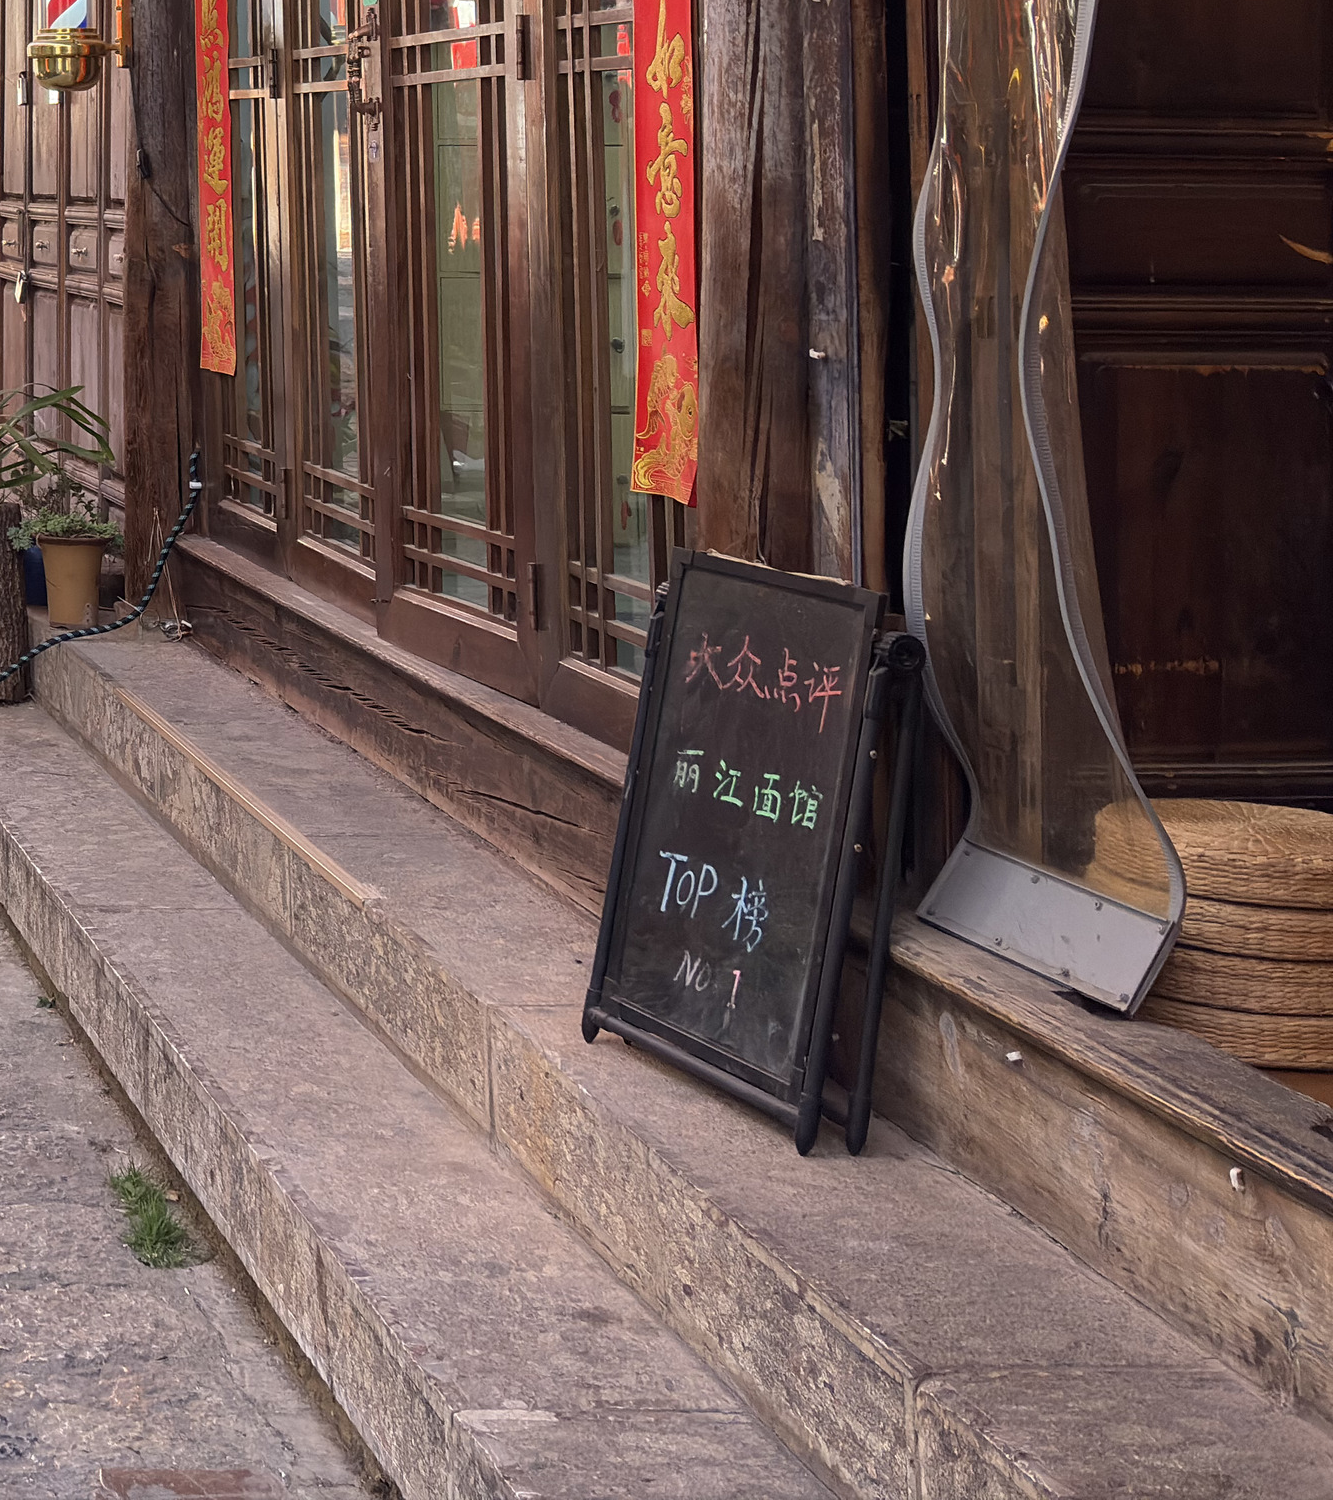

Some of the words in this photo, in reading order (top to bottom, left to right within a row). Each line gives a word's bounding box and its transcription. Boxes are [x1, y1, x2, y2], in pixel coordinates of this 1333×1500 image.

[685, 632, 843, 733] 大众点评
[674, 749, 824, 830] 丽江面馆
[721, 875, 769, 953] 榜
